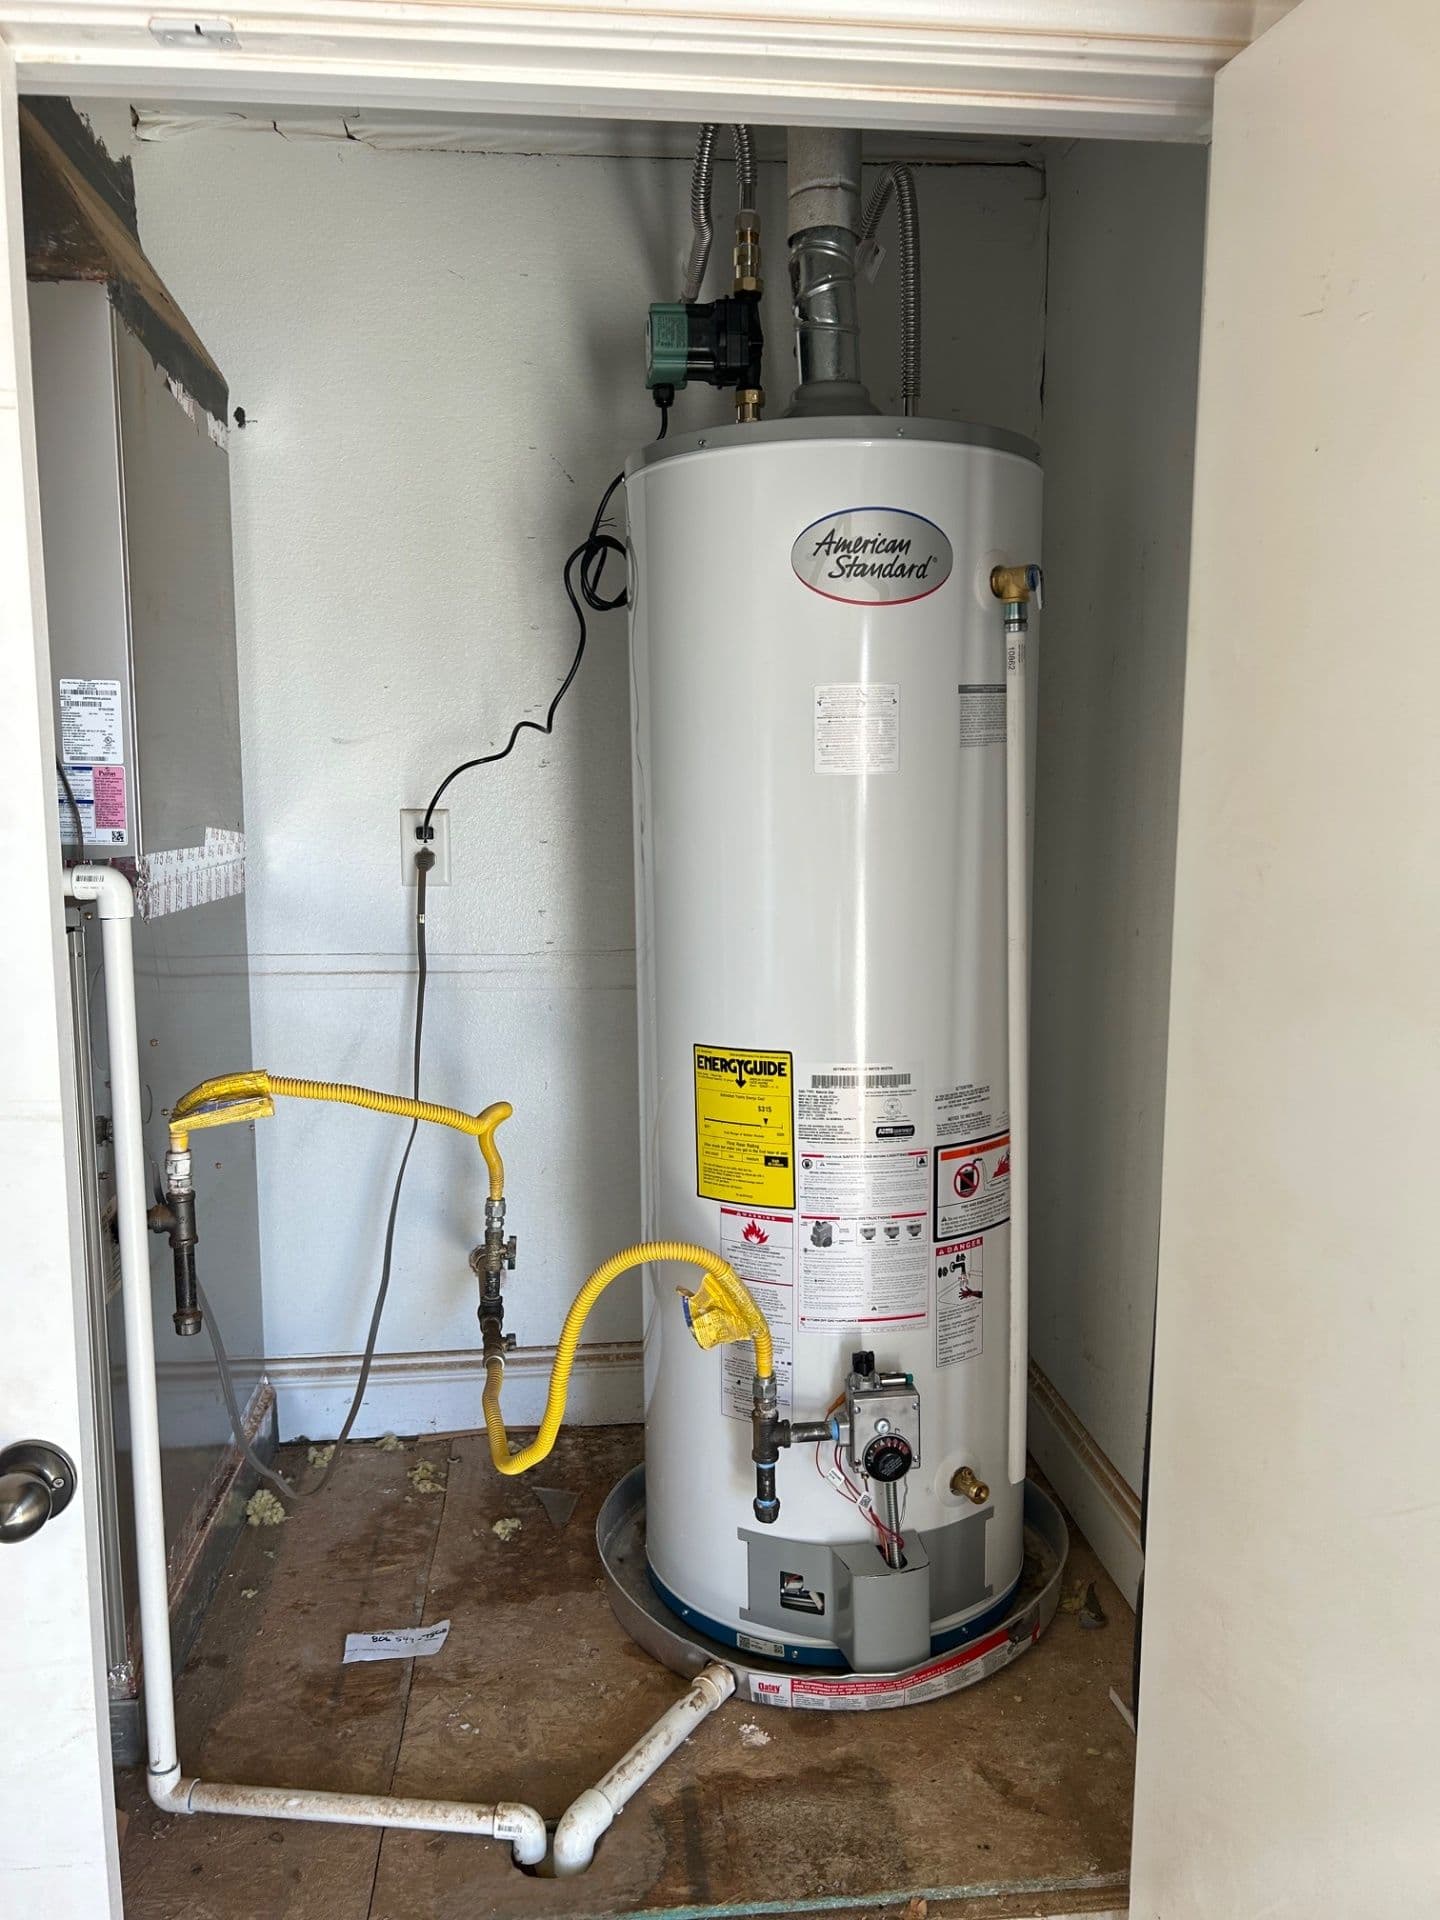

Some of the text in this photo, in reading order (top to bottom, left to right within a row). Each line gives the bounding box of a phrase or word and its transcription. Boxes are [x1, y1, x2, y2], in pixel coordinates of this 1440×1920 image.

[812, 528, 911, 557] American
[828, 555, 933, 579] Standard
[697, 1054, 787, 1078] ENERGYGUIDE
[946, 1239, 982, 1253] DANGER
